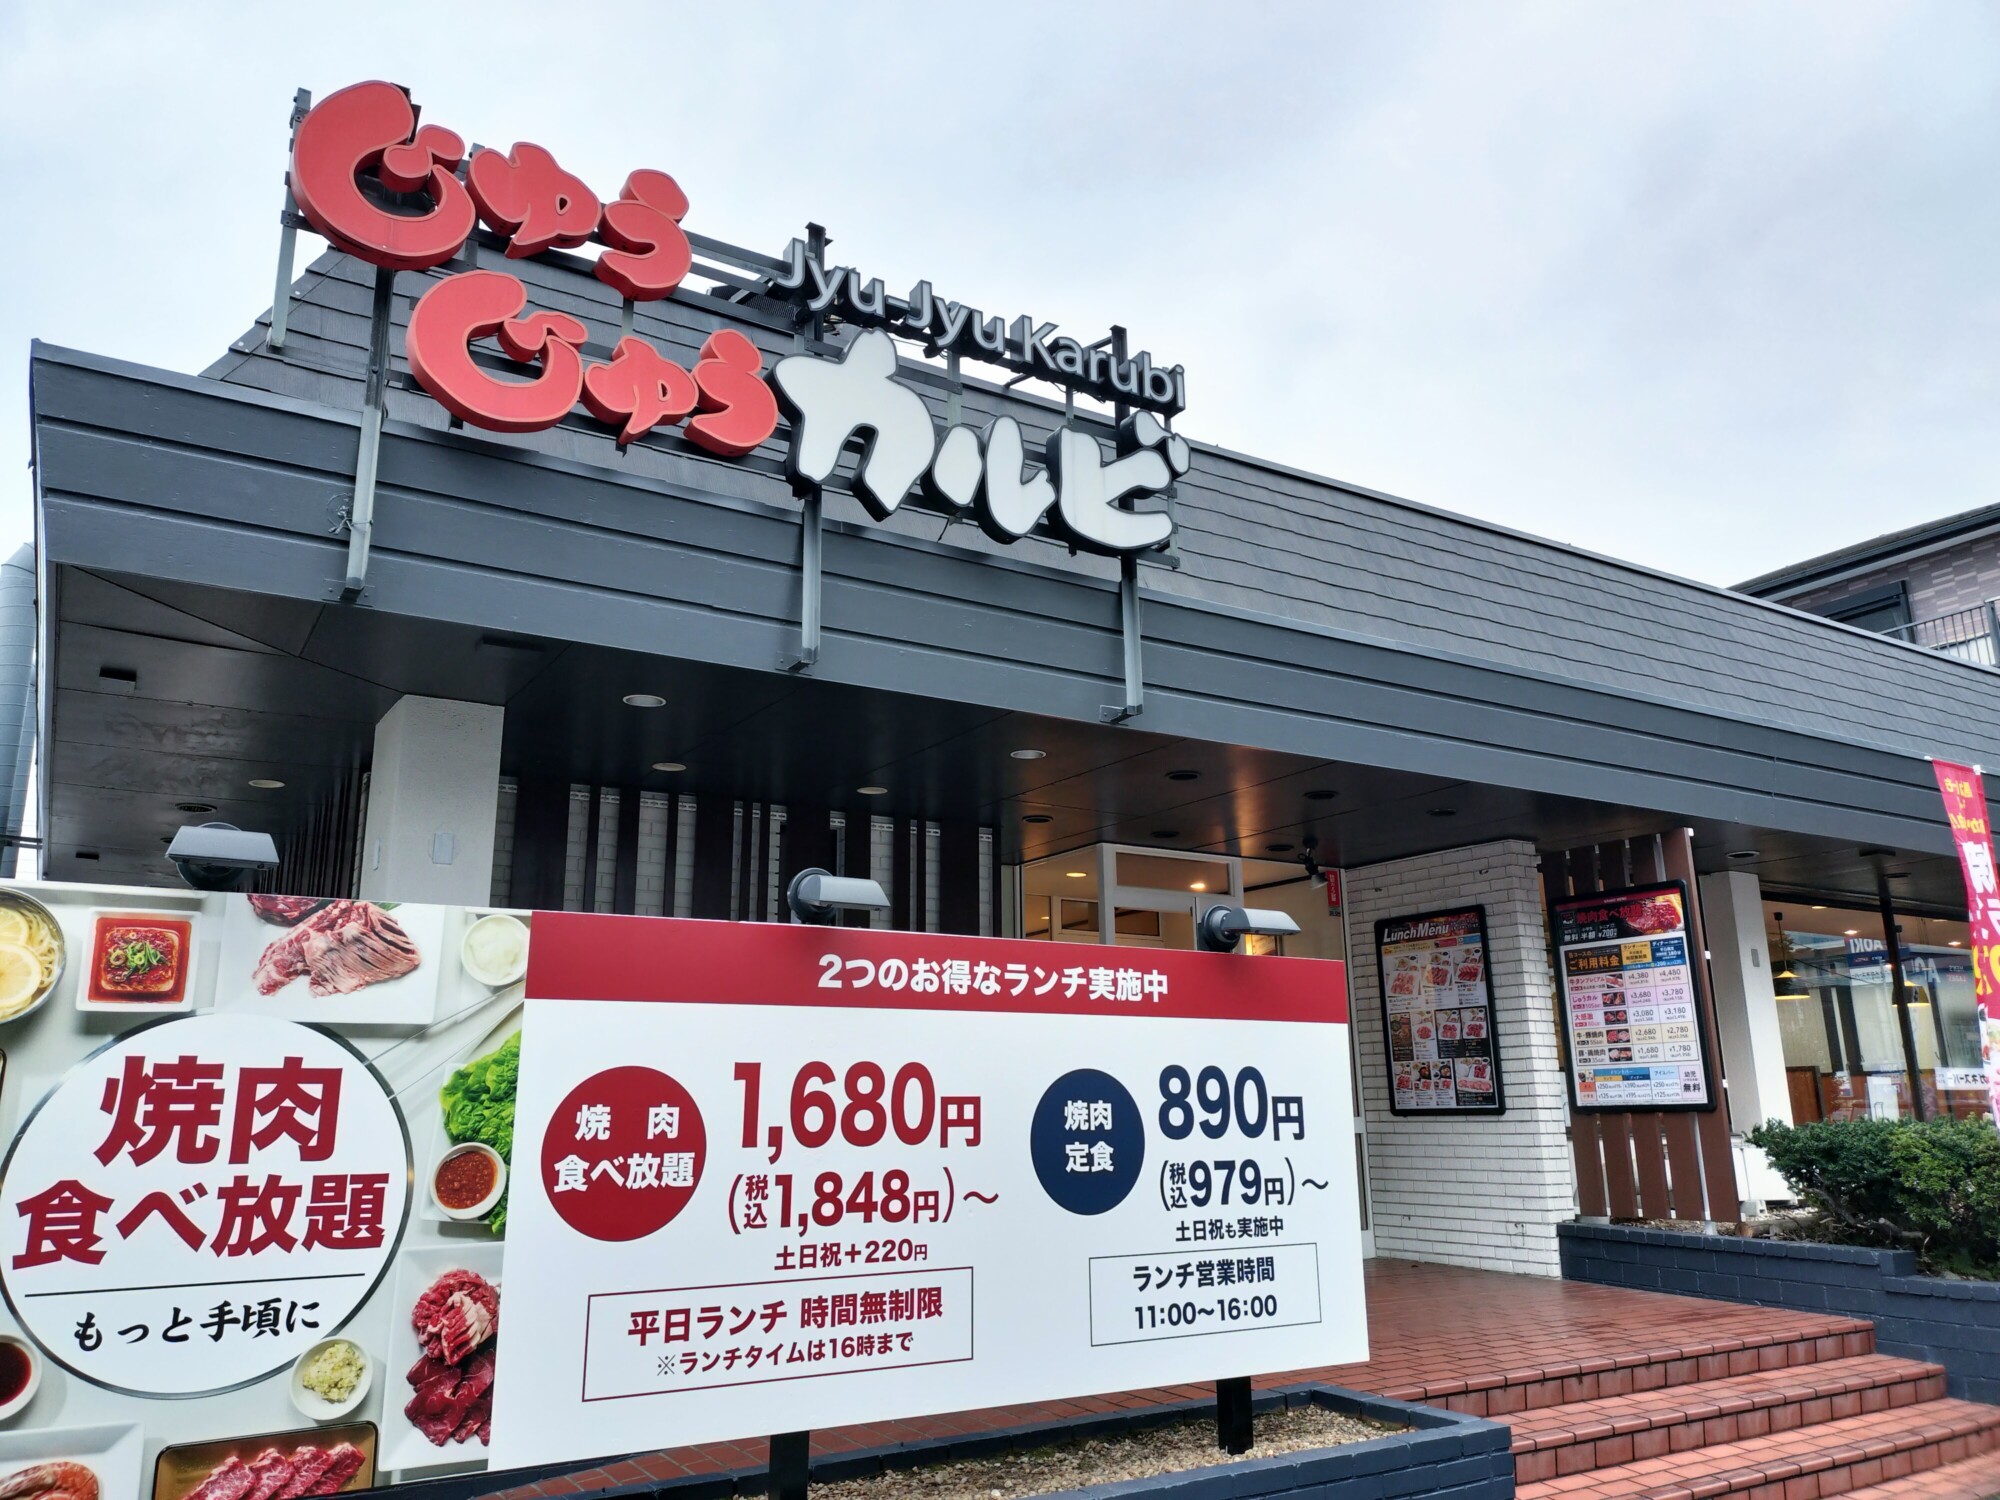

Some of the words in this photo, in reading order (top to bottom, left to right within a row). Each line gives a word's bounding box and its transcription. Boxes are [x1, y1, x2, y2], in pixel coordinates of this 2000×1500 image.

[290, 80, 692, 302] じゅう
[780, 235, 1006, 352] Jyu-Jyu
[1009, 313, 1186, 417] Karubi
[406, 269, 1191, 554] じゅうカルビ
[818, 955, 1168, 1003] 2つのお得なランチ実施中
[1570, 955, 1620, 970] ご利用料金
[95, 1056, 343, 1167] 焼肉
[733, 1060, 982, 1160] 1,680円
[1158, 1064, 1305, 1142] 890円
[1683, 1083, 1701, 1092] 無料
[575, 1103, 680, 1141] 焼肉
[1064, 1100, 1113, 1131] 焼肉
[554, 1153, 694, 1193] 食べ放題
[1065, 1141, 1114, 1173] 定食
[12, 1172, 390, 1270] 食べ放題
[1175, 1215, 1284, 1242] 土日祝も実施中
[1133, 1256, 1276, 1293] ランチ営業時間
[74, 1298, 320, 1352] もっと手頃に
[627, 1302, 787, 1346] 平日ランチ
[799, 1286, 943, 1330] 時間無制限
[656, 1331, 914, 1377] ※ランチタイムは16時まで
